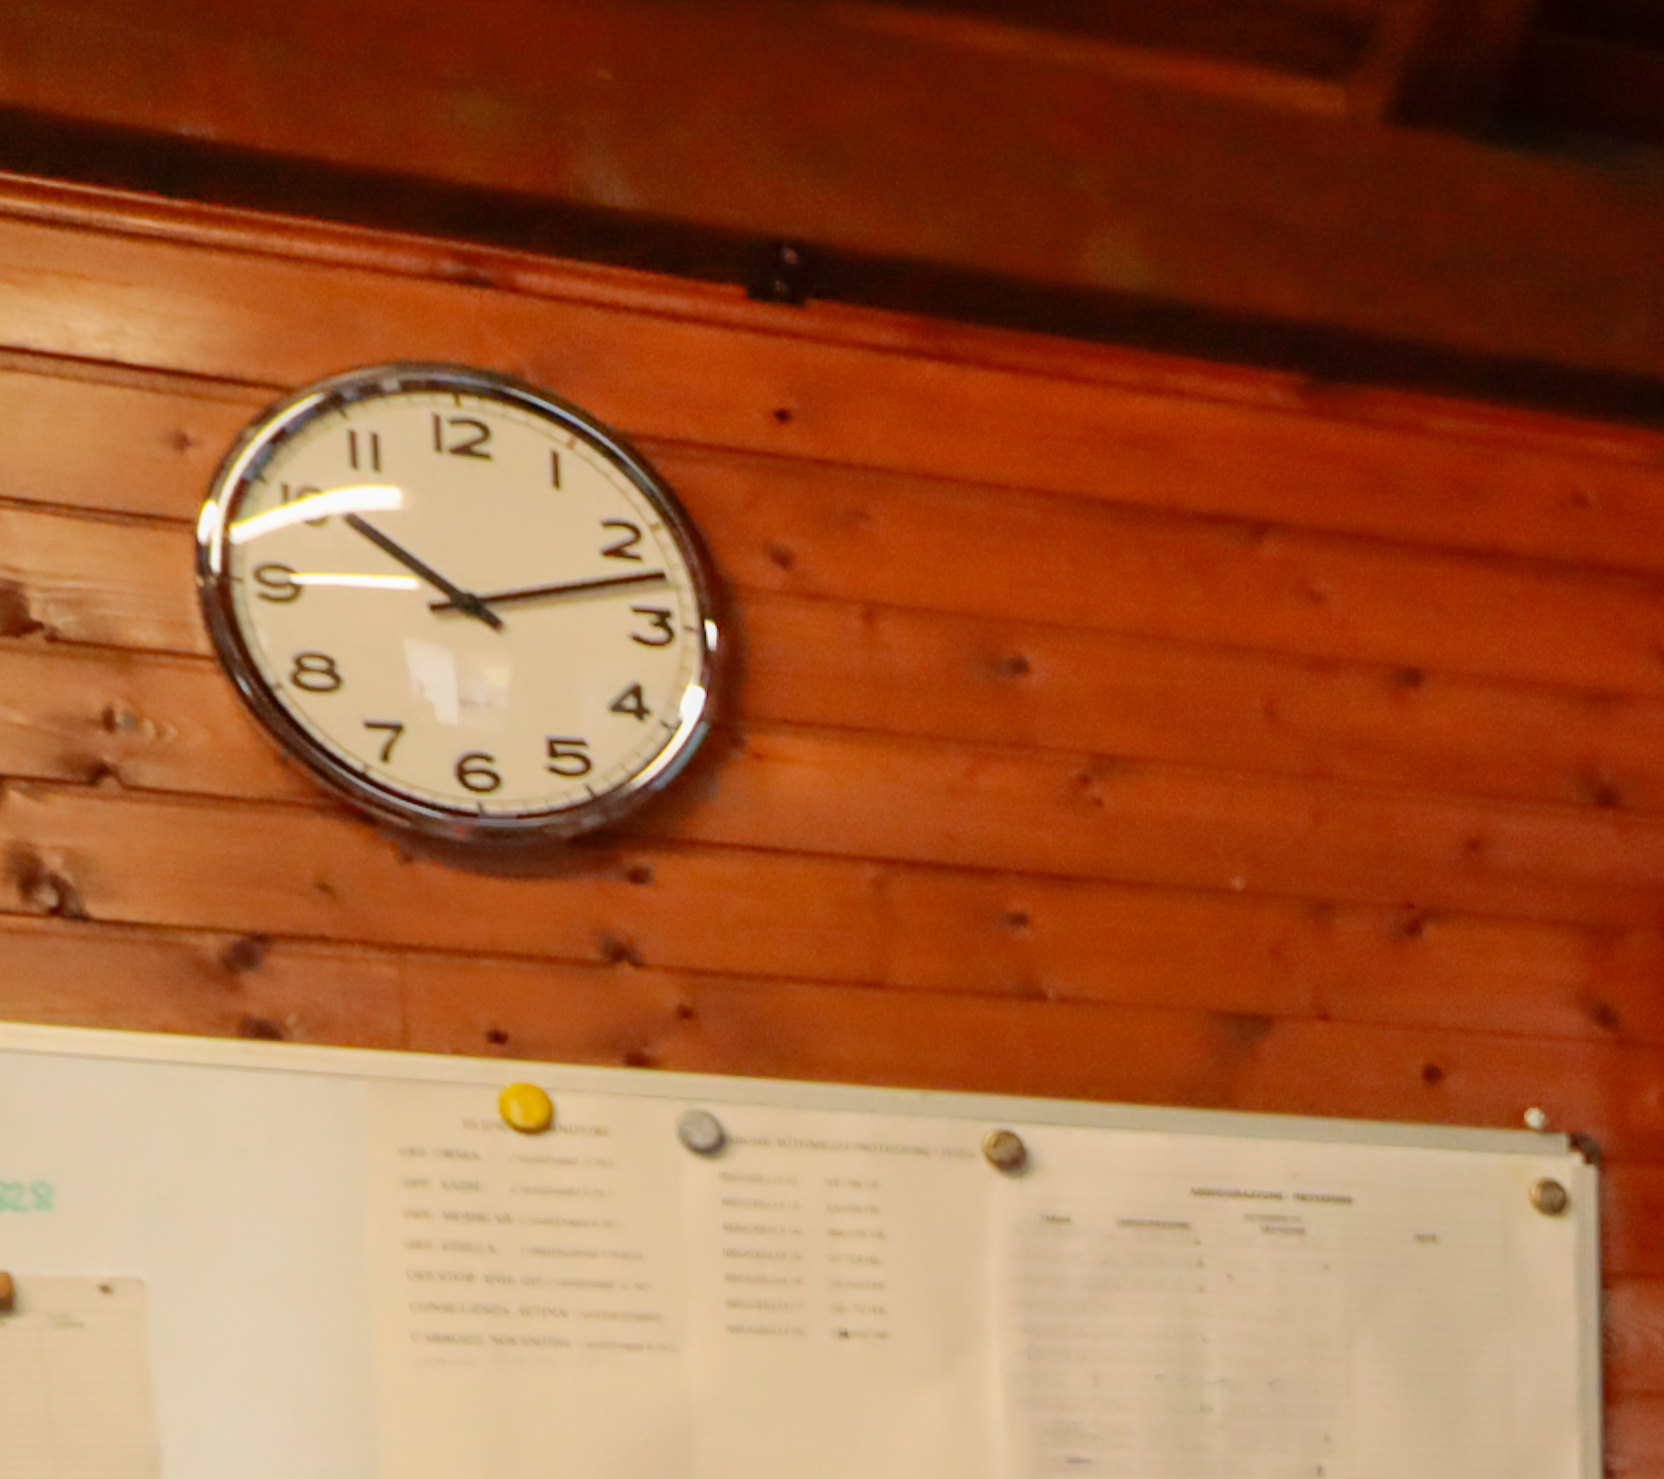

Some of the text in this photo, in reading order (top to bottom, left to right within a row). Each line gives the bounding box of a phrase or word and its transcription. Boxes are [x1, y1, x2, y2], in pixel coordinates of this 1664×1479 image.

[348, 429, 382, 472] 11
[432, 413, 494, 460] 12
[549, 450, 562, 489] 1
[598, 520, 643, 561] 2
[255, 563, 303, 605] 9
[630, 607, 674, 647] 3
[291, 654, 344, 693] 8
[608, 684, 651, 723] 4
[365, 722, 404, 763] 7
[547, 739, 593, 777] 5
[454, 753, 502, 793] 6
